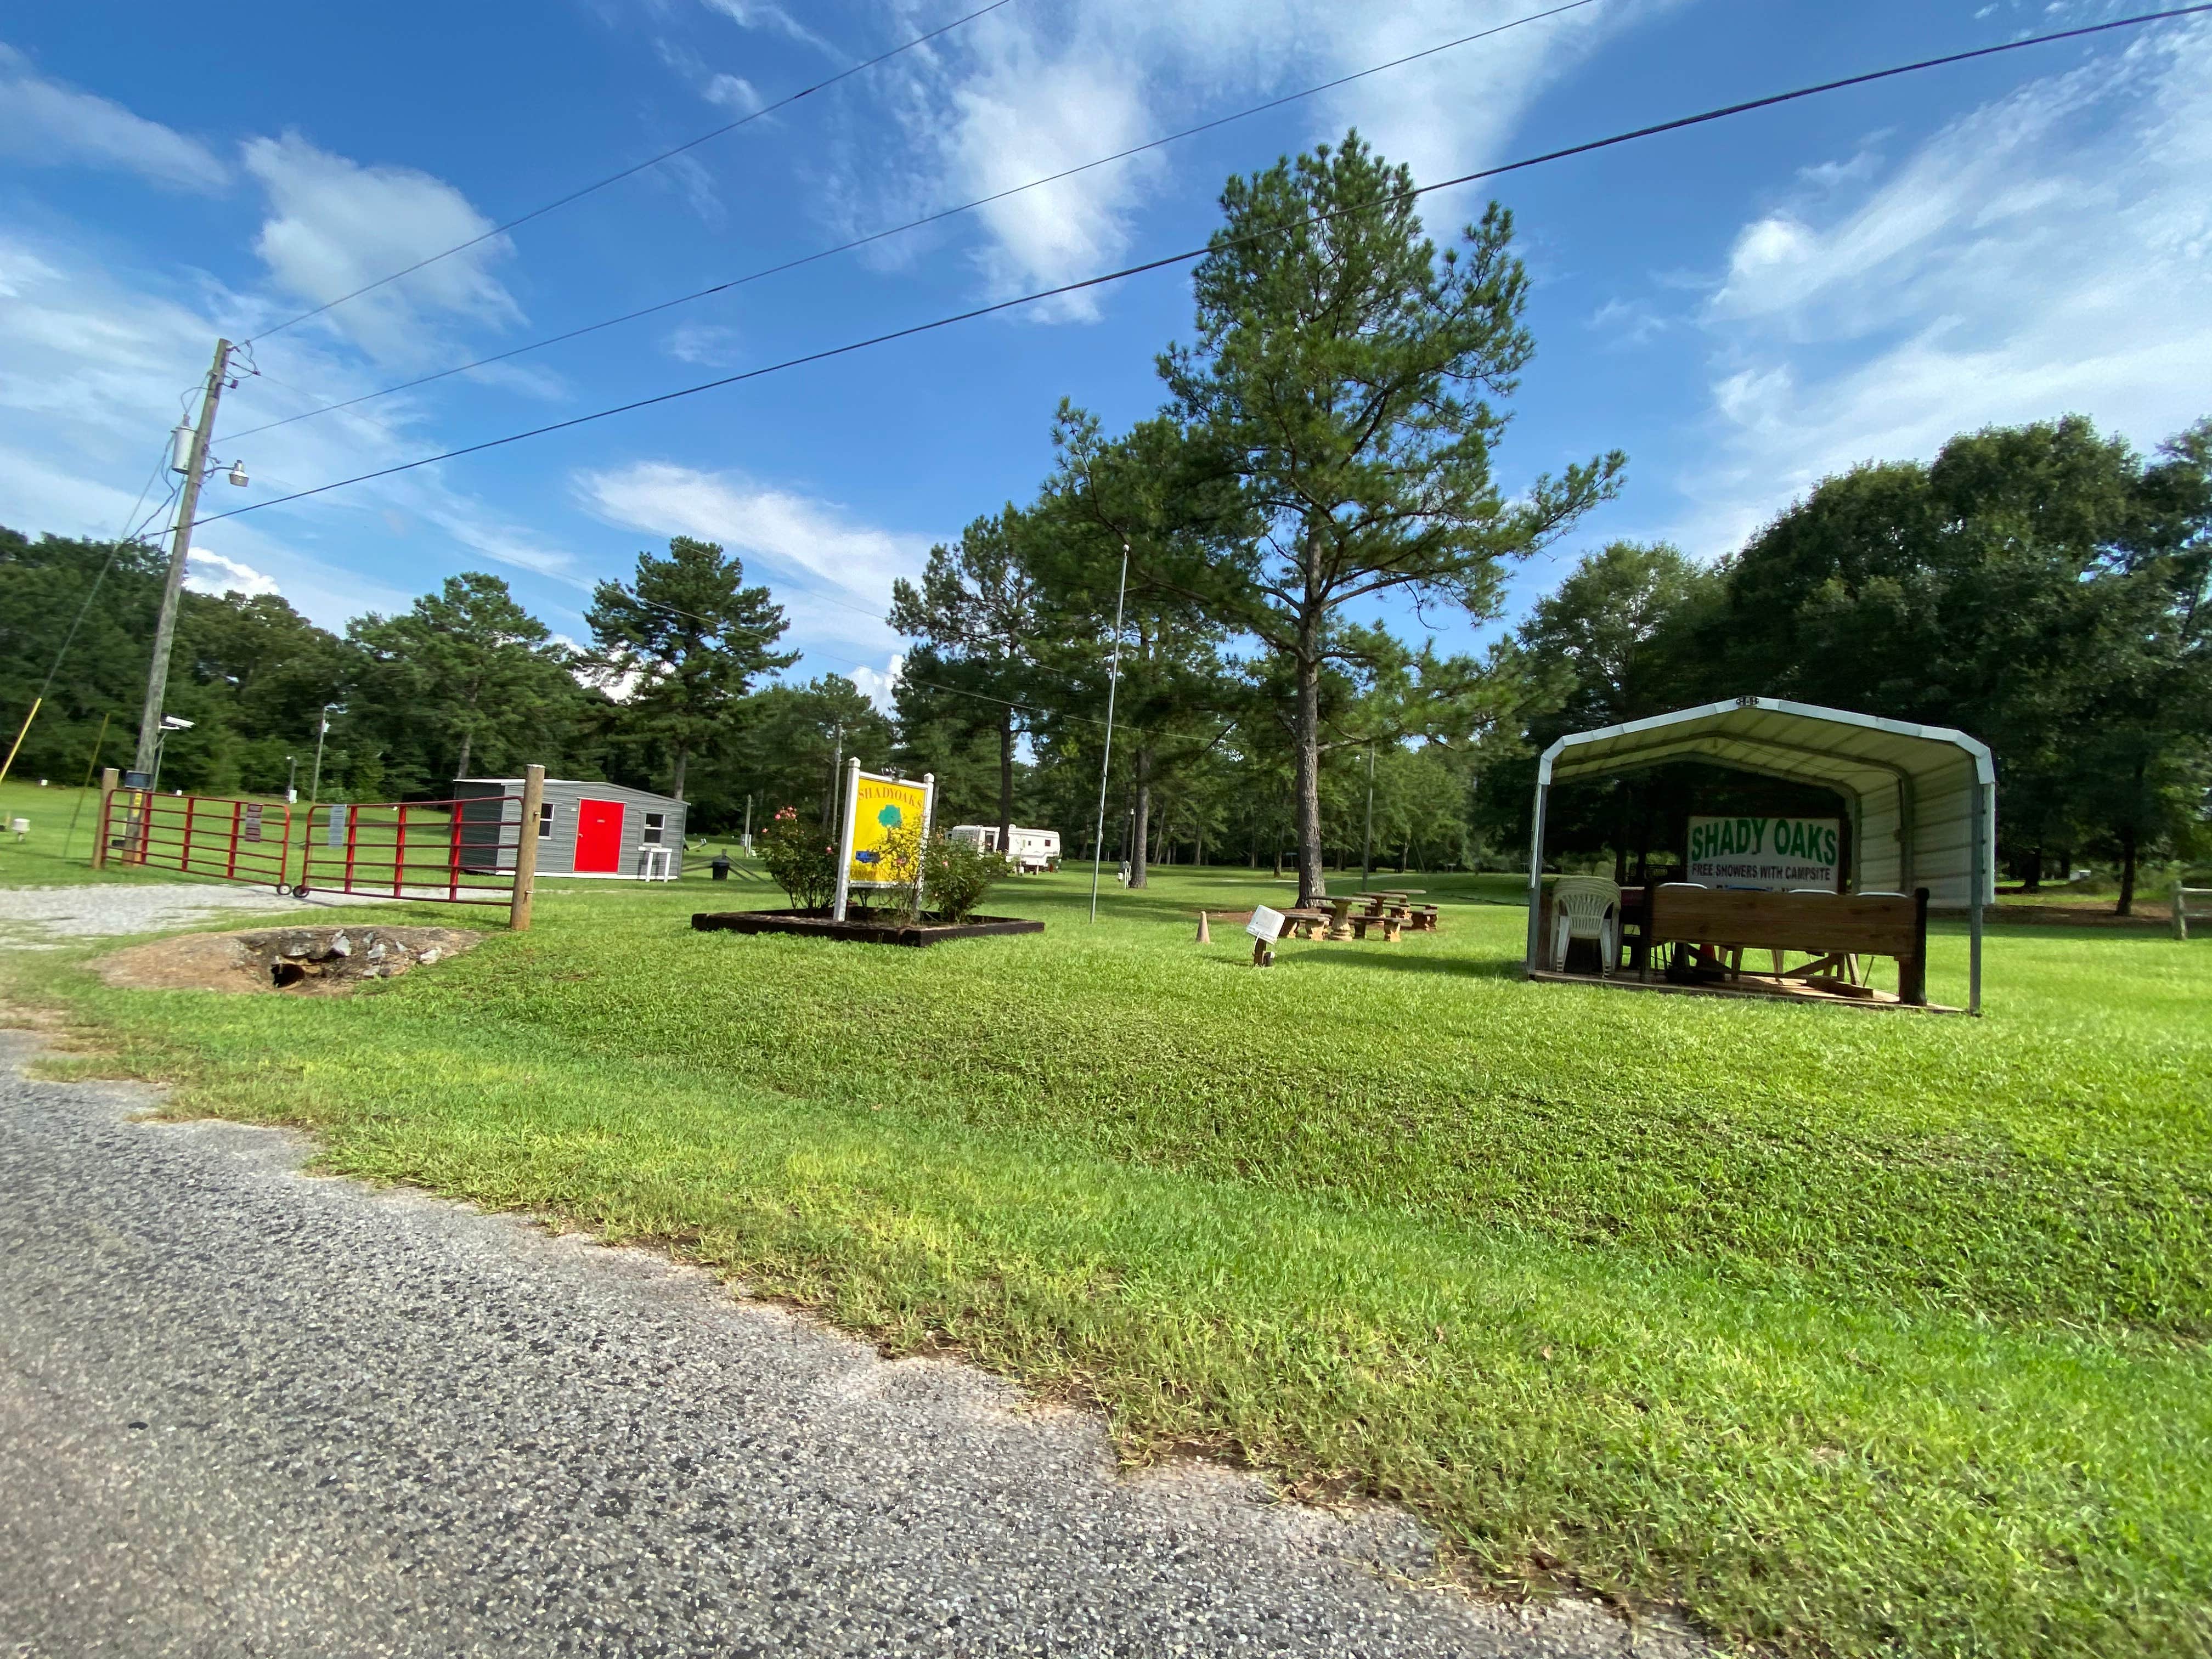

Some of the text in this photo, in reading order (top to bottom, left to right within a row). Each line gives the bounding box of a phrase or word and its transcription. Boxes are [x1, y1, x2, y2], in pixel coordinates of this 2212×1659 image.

[1691, 819, 1837, 866] SHADY OAKS
[1692, 863, 1831, 881] FREE SHOWERS WITH CAMPSITE
